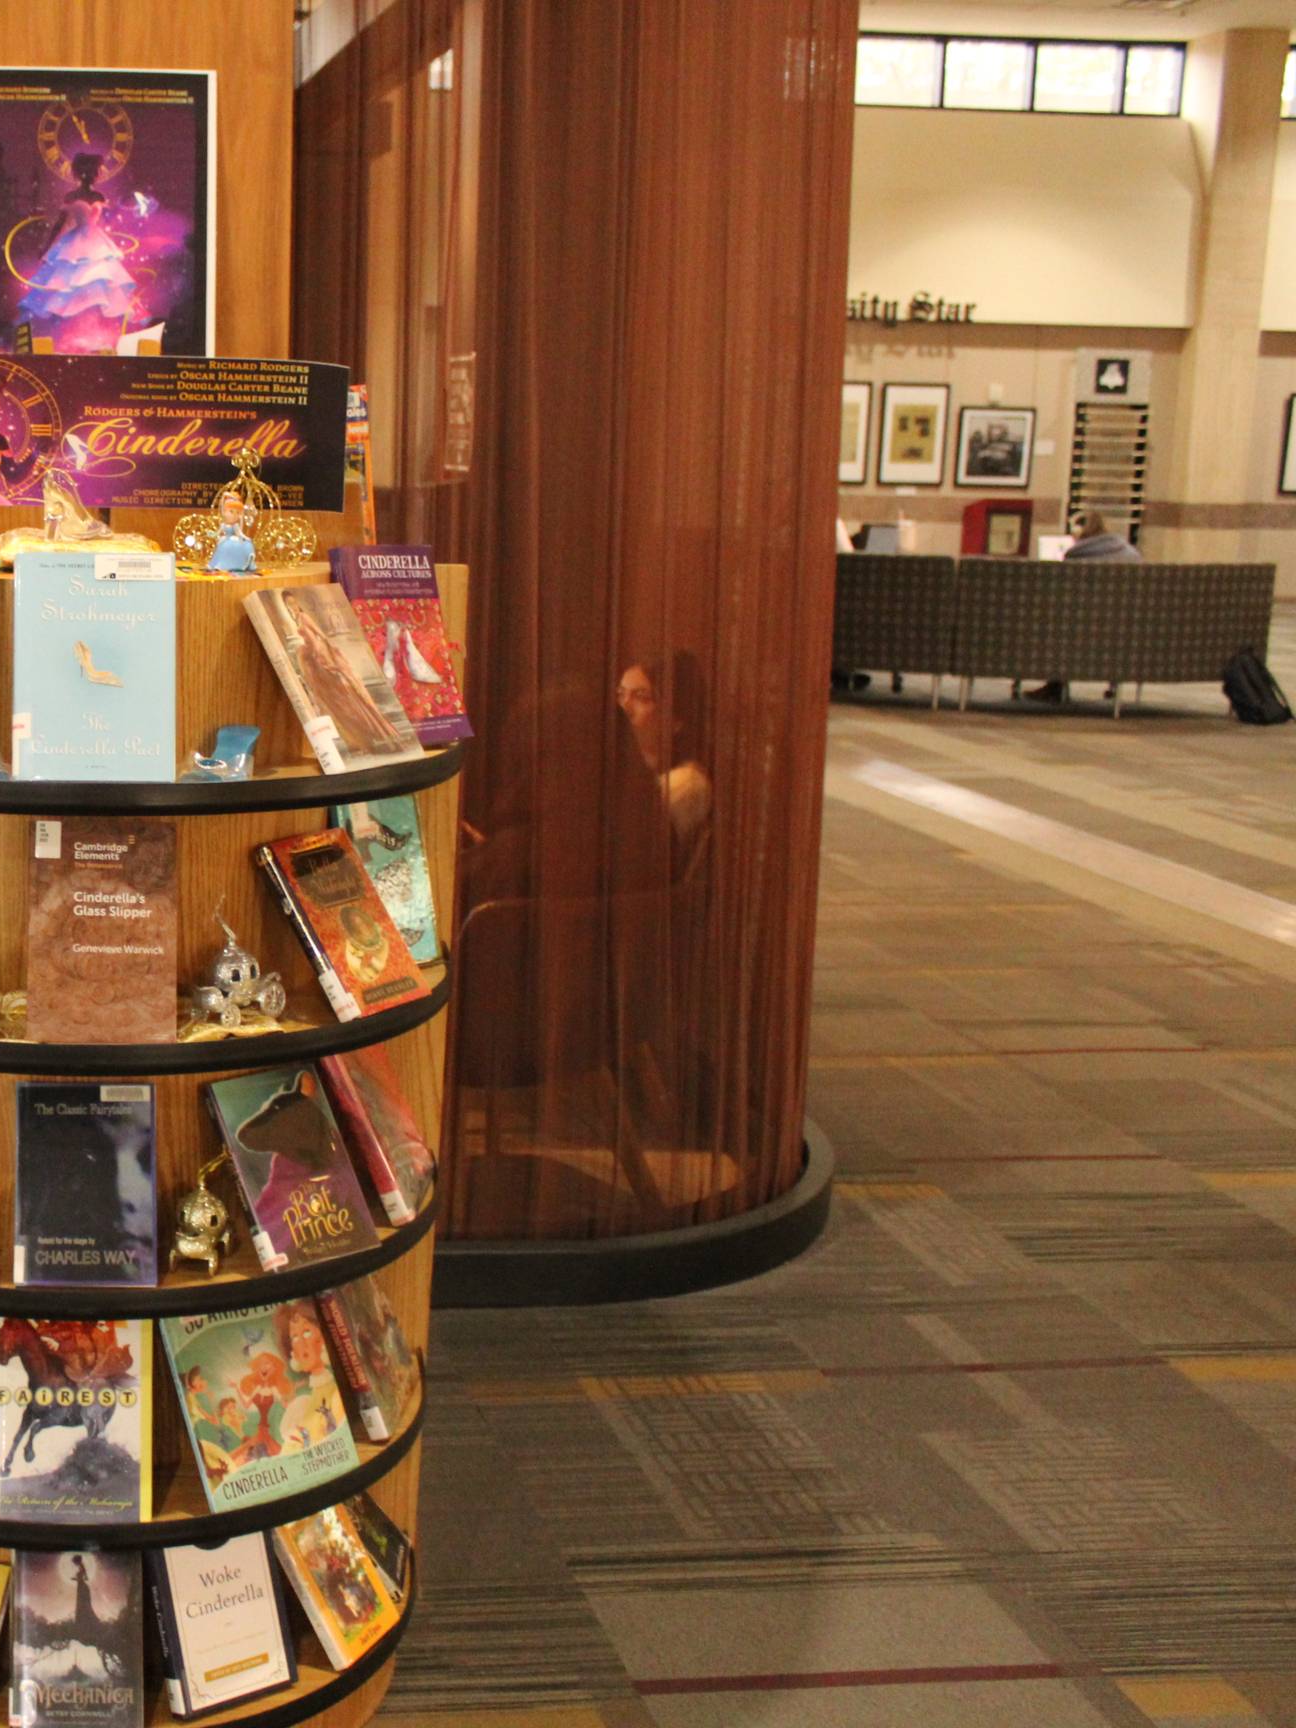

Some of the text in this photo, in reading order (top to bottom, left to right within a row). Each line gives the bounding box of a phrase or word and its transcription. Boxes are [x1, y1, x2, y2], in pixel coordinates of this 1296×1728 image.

[908, 290, 976, 324] Star
[209, 360, 257, 371] RICHARD
[260, 362, 310, 375] RODGERS
[179, 370, 216, 381] OSCAR
[218, 372, 299, 385] HAMMERSTEIN
[300, 374, 309, 385] II
[177, 381, 226, 392] DOUGLAS
[228, 382, 271, 393] CARTER
[273, 384, 309, 396] BEANE
[179, 391, 215, 402] OSCAR
[217, 393, 297, 405] HAMMERSTEIN
[298, 394, 308, 406] II
[84, 406, 141, 418] RODGERS
[156, 406, 258, 420] HAMMERSTEIN'S
[78, 417, 306, 462] Cinderella
[112, 496, 139, 504] MUSIC
[142, 496, 194, 505] DIRECTION
[133, 488, 198, 498] CHOREOGRAPHY
[358, 554, 431, 570] CINDERELLA
[361, 570, 432, 579] ACROSS CULTURES
[68, 575, 129, 597] Sarah
[40, 598, 158, 632] Strohmeyer
[81, 711, 112, 732] The
[32, 734, 118, 757] Cinderella
[73, 841, 129, 854] Cambridge
[74, 850, 121, 862] Elements
[73, 890, 146, 905] Cinderella's
[73, 905, 153, 920] Glass Slipper
[72, 943, 166, 956] Genevieve Warwick
[34, 1102, 54, 1116] The
[56, 1102, 88, 1116] Classic
[289, 1185, 336, 1218] Rat
[283, 1207, 353, 1249] Prince
[35, 1250, 136, 1265] CHARLES WAY
[313, 1437, 345, 1459] WICKED
[302, 1449, 350, 1476] STEPMOTHER
[222, 1465, 289, 1500] CINDERELLA
[198, 1565, 242, 1589] Woke
[184, 1583, 265, 1619] Cinderella
